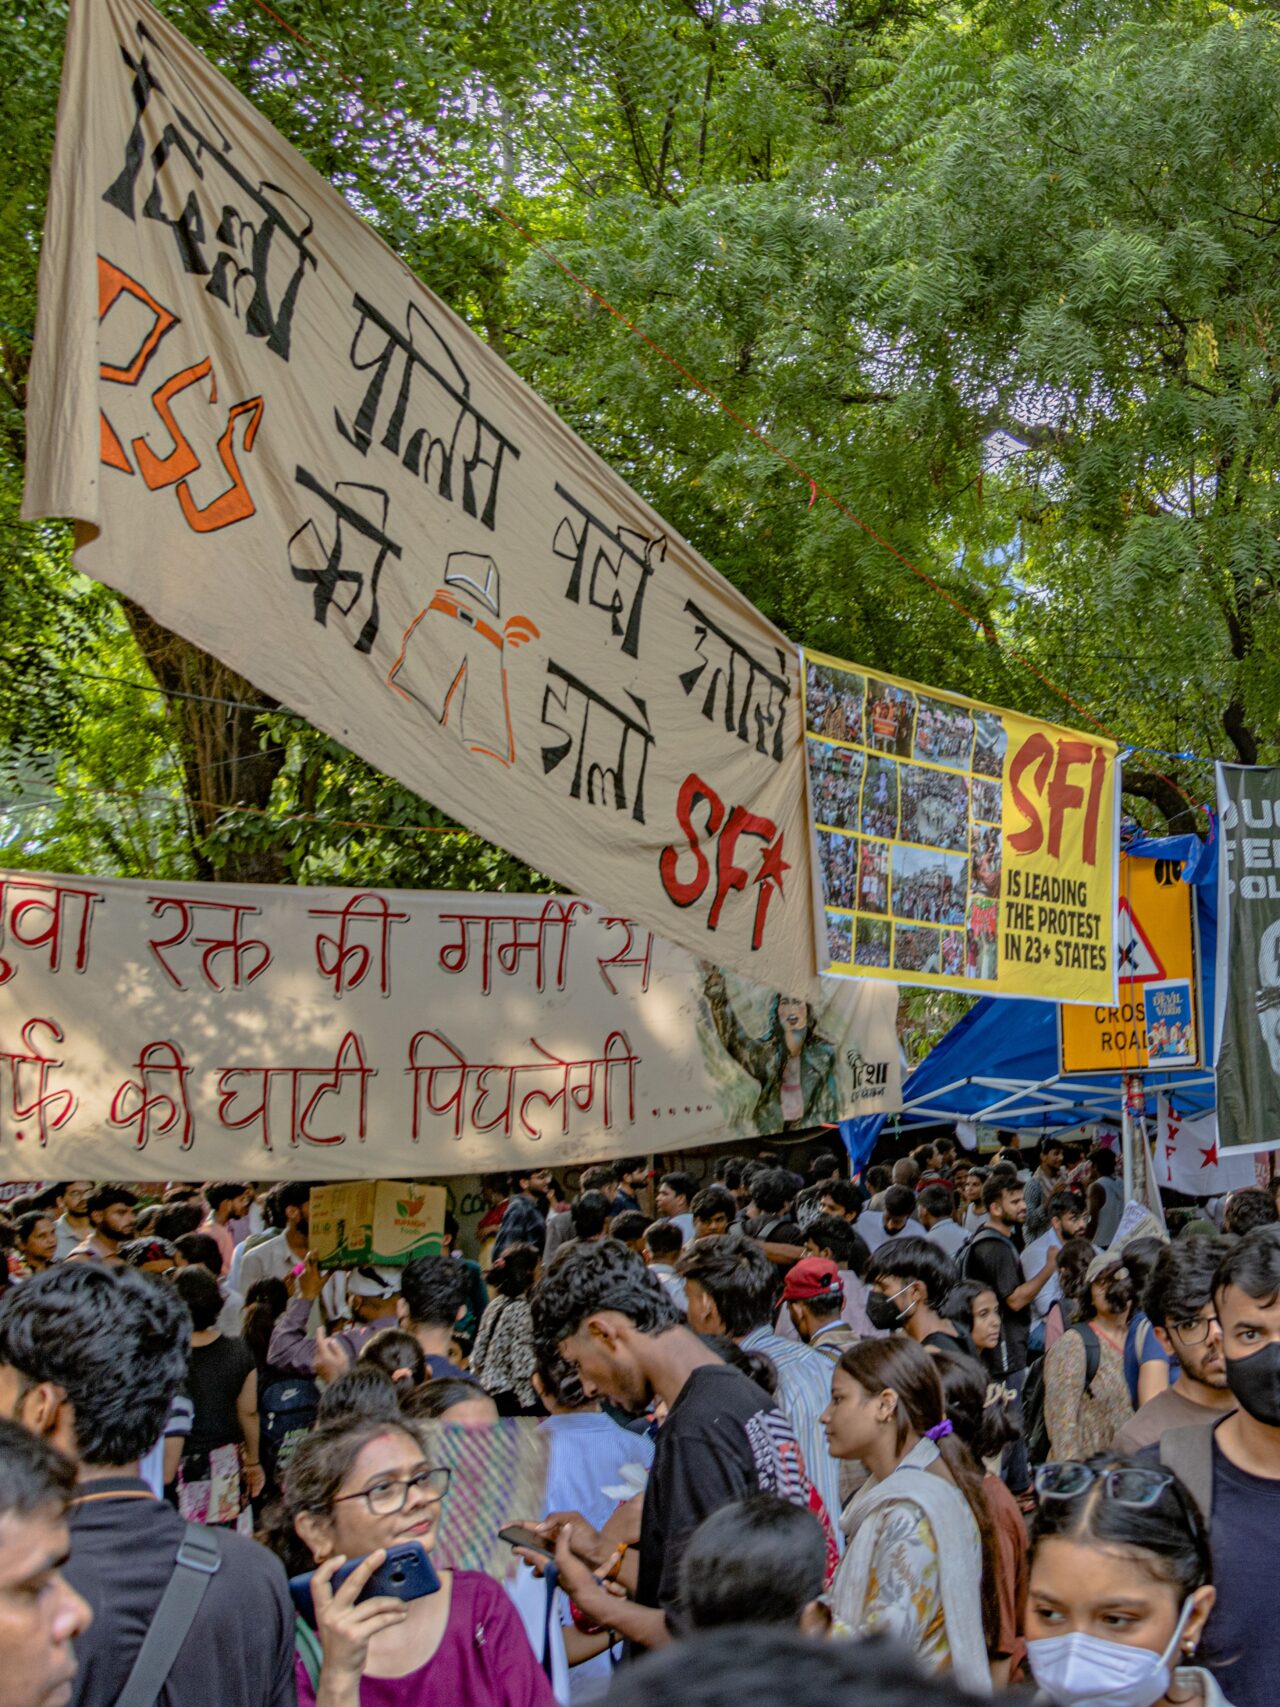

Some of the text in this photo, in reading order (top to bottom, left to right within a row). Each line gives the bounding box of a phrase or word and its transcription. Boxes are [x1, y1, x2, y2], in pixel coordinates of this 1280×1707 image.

[102, 19, 318, 362] दिल्ली
[334, 292, 520, 531] पुलिस
[553, 481, 668, 658] वर्दी
[288, 464, 402, 654] की
[541, 658, 654, 824] डालो
[1007, 732, 1105, 866] SFI
[659, 772, 783, 950] SFI
[1006, 869, 1087, 907] IS LEADING
[1006, 901, 1101, 941] THE PROTEST
[148, 896, 273, 991] रक्त
[308, 893, 410, 999] की
[439, 899, 591, 995] गर्मी
[1005, 933, 1106, 971] IN 23+ STATES
[107, 1040, 193, 1151] की
[217, 1031, 378, 1151] घाटी
[404, 1030, 641, 1141] पिघलेगी
